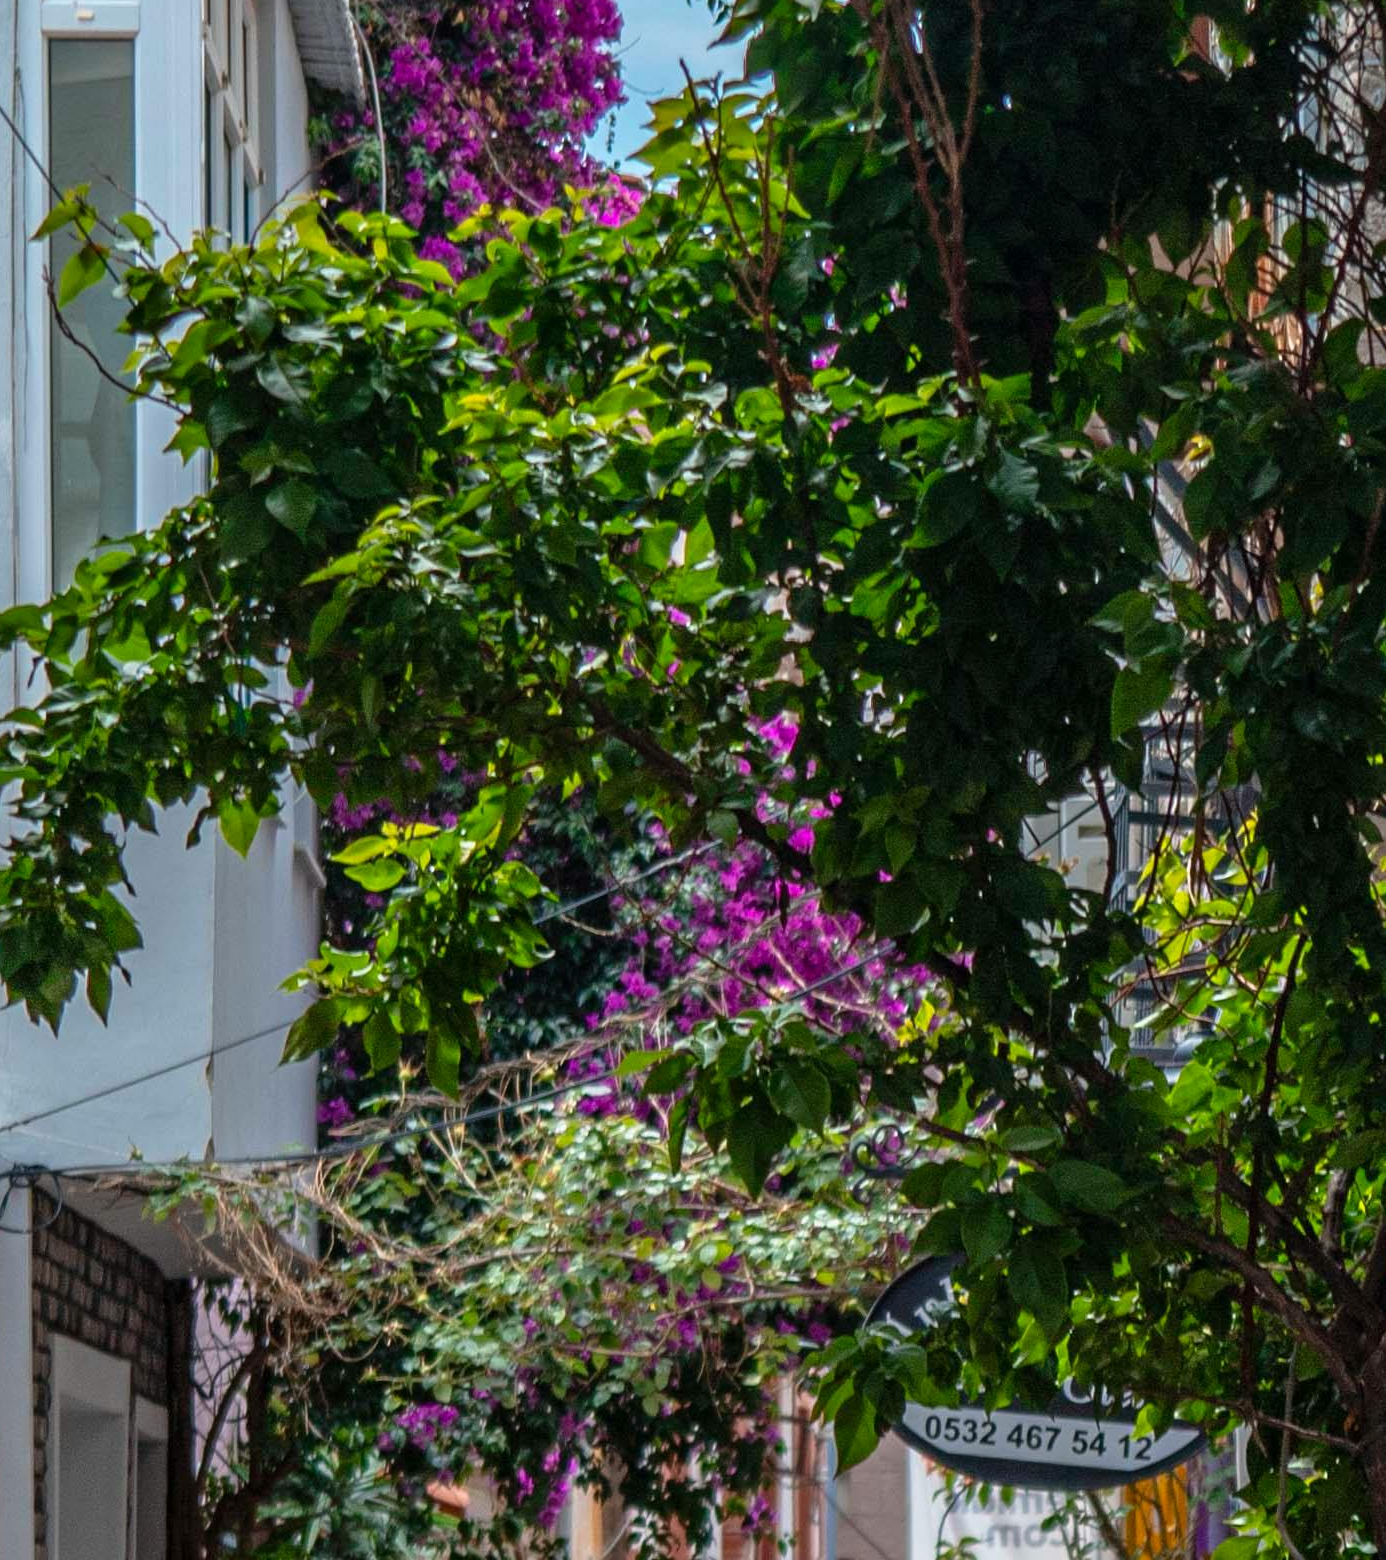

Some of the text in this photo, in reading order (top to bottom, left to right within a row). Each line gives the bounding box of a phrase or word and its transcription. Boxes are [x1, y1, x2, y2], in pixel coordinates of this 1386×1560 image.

[924, 1414, 1152, 1461] 0532 467 54 12
